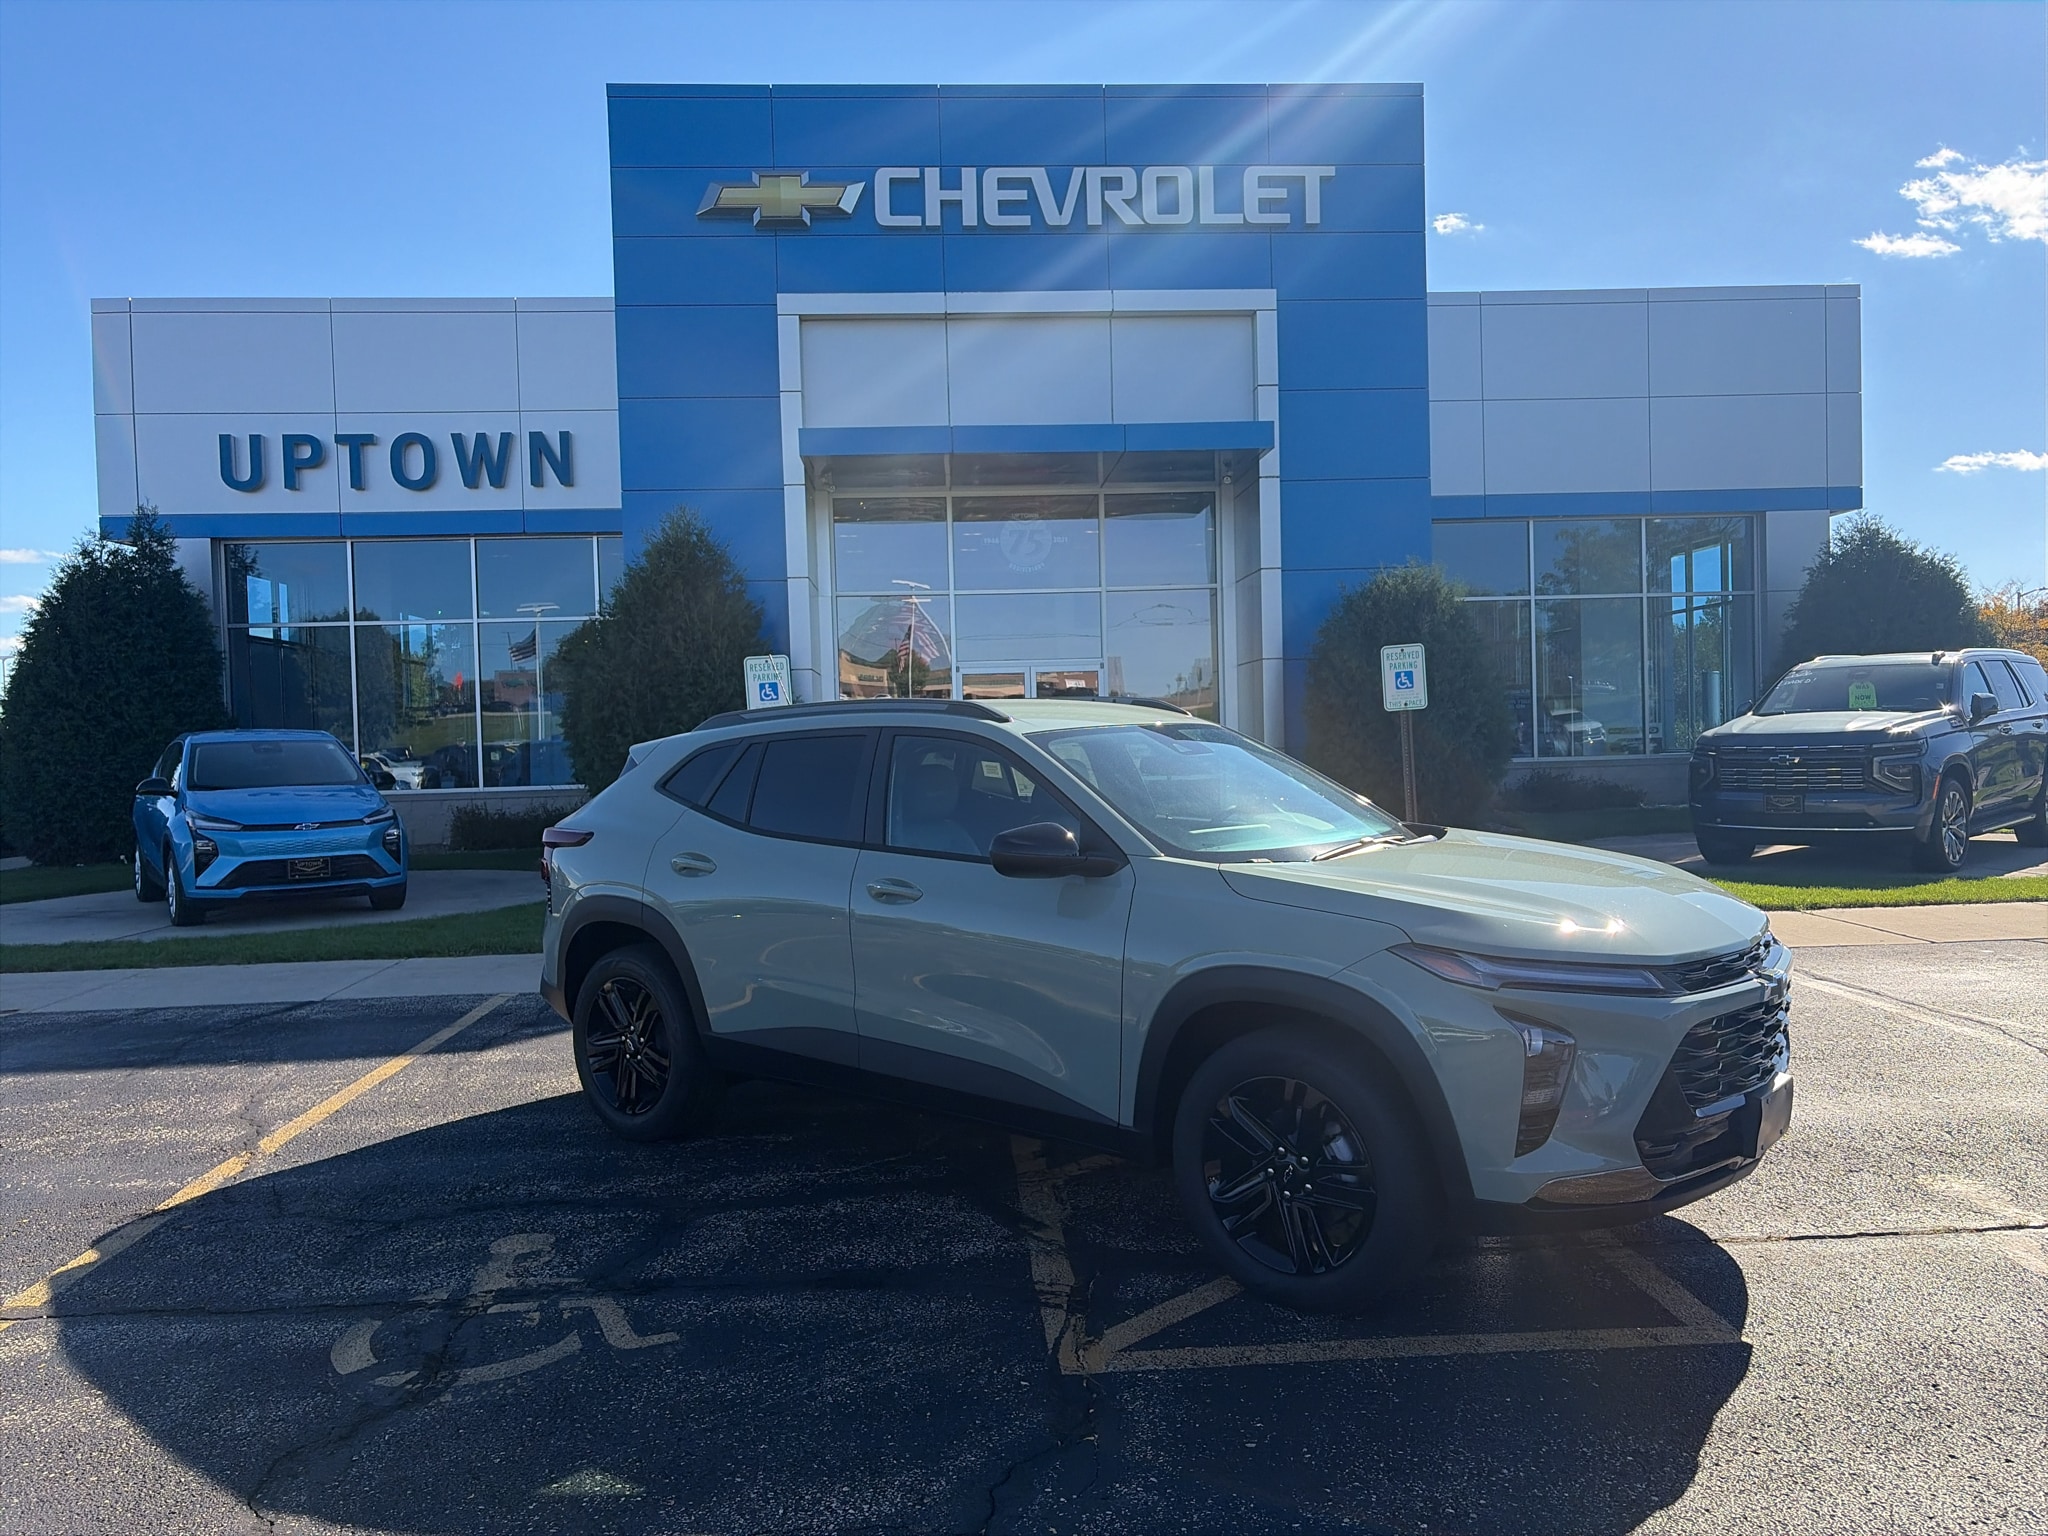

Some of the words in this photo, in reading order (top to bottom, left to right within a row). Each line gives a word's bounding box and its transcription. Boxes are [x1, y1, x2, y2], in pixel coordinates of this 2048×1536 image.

[874, 165, 1336, 227] CHEVROLET
[218, 430, 574, 493] UPTOWN
[1008, 528, 1043, 556] 75
[1386, 650, 1420, 661] RESERVED
[1389, 661, 1418, 671] PARKING
